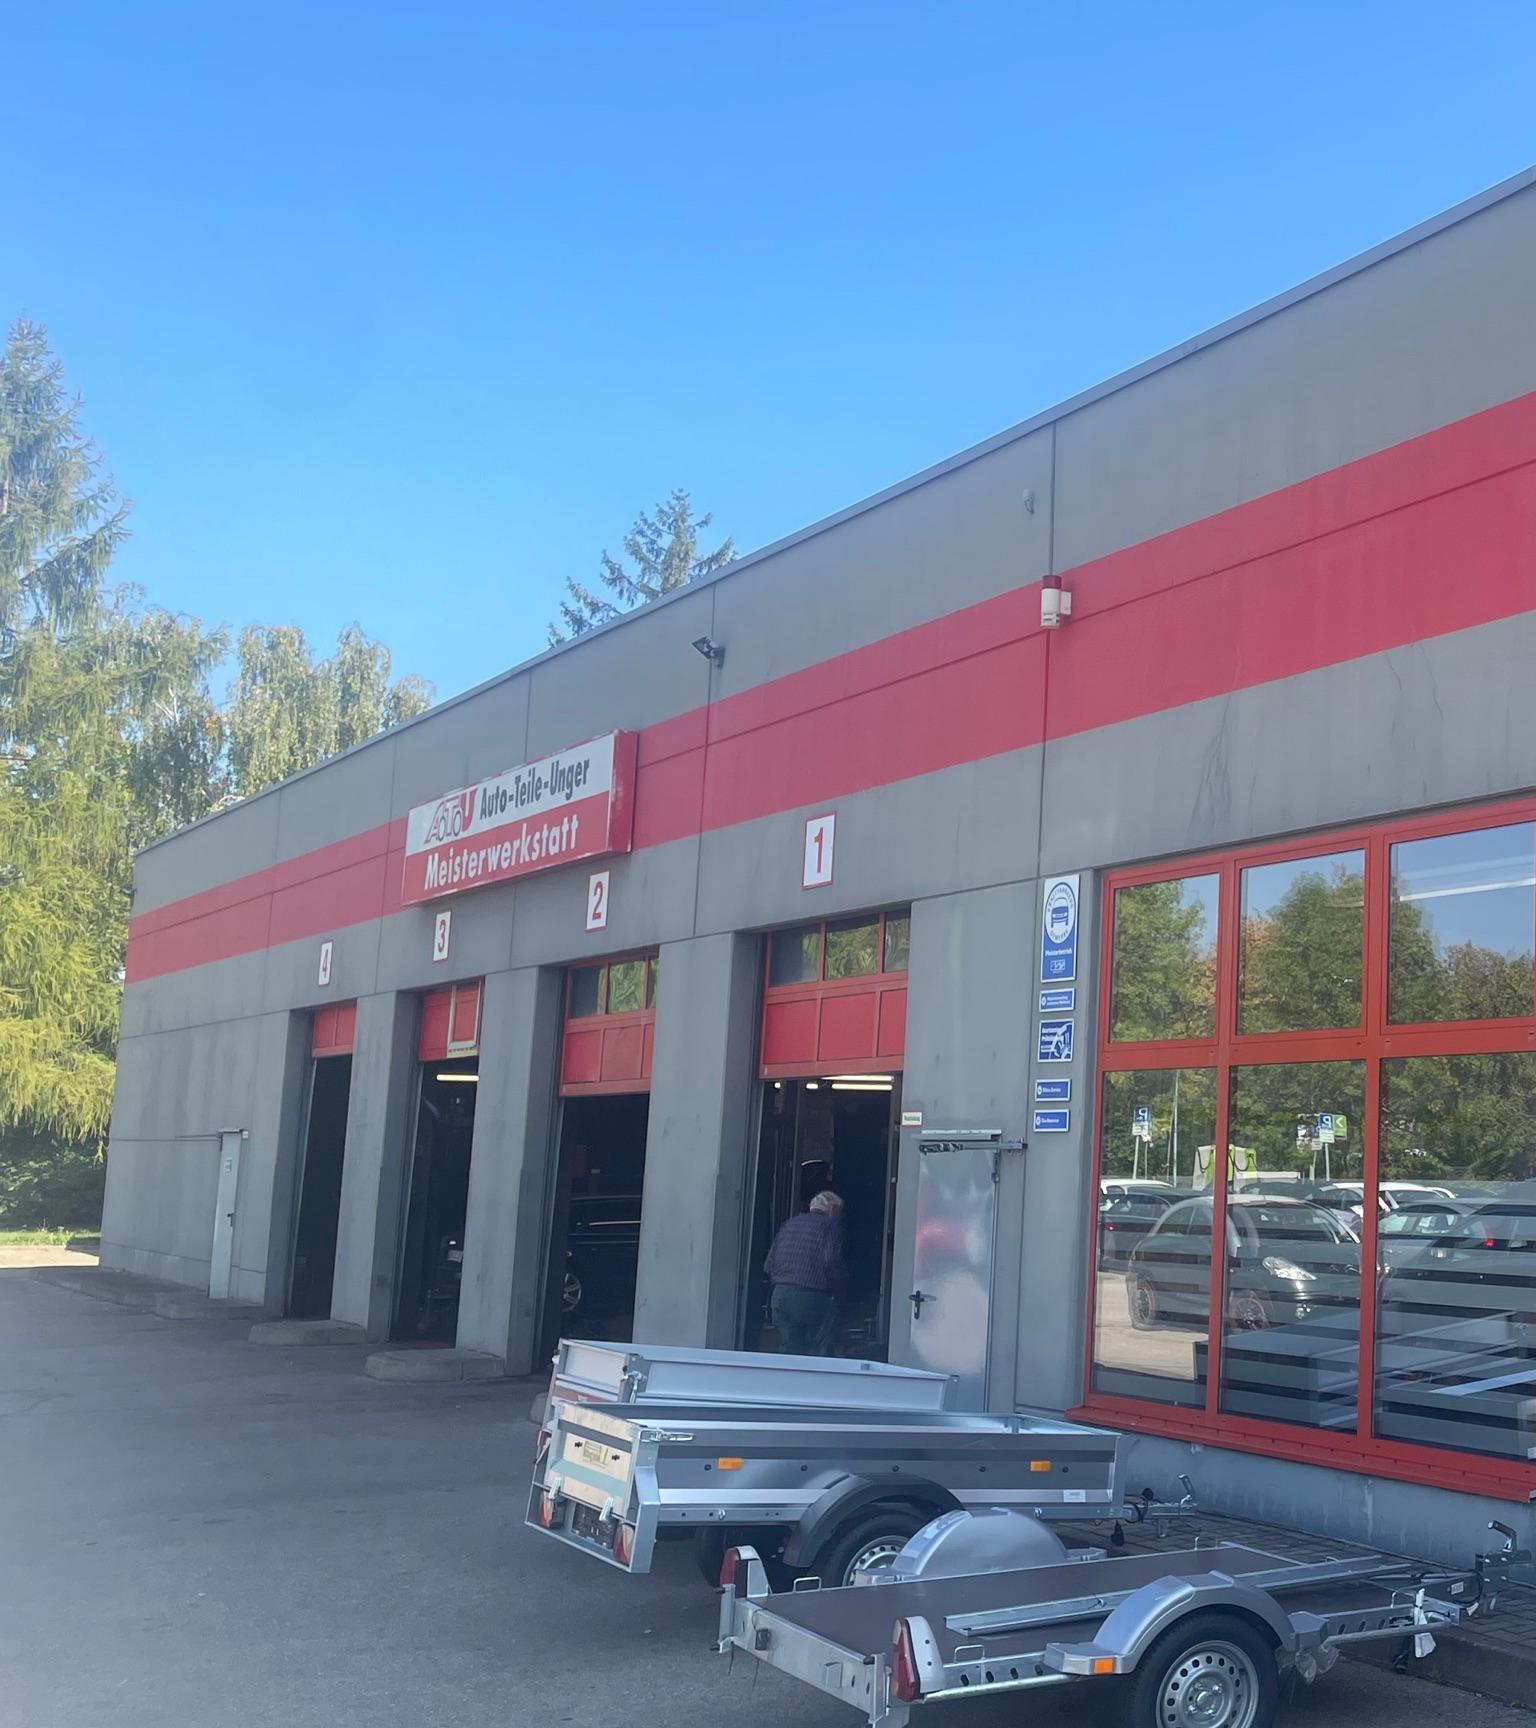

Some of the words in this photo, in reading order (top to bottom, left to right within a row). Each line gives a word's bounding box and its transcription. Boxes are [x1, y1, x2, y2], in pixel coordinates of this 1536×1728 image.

[480, 758, 591, 820] Auto-Teile-Unger
[424, 814, 578, 891] Meisterwerkstatt
[814, 827, 824, 874] 1
[592, 881, 604, 921] 2
[437, 919, 446, 953] 3
[322, 949, 329, 978] 4
